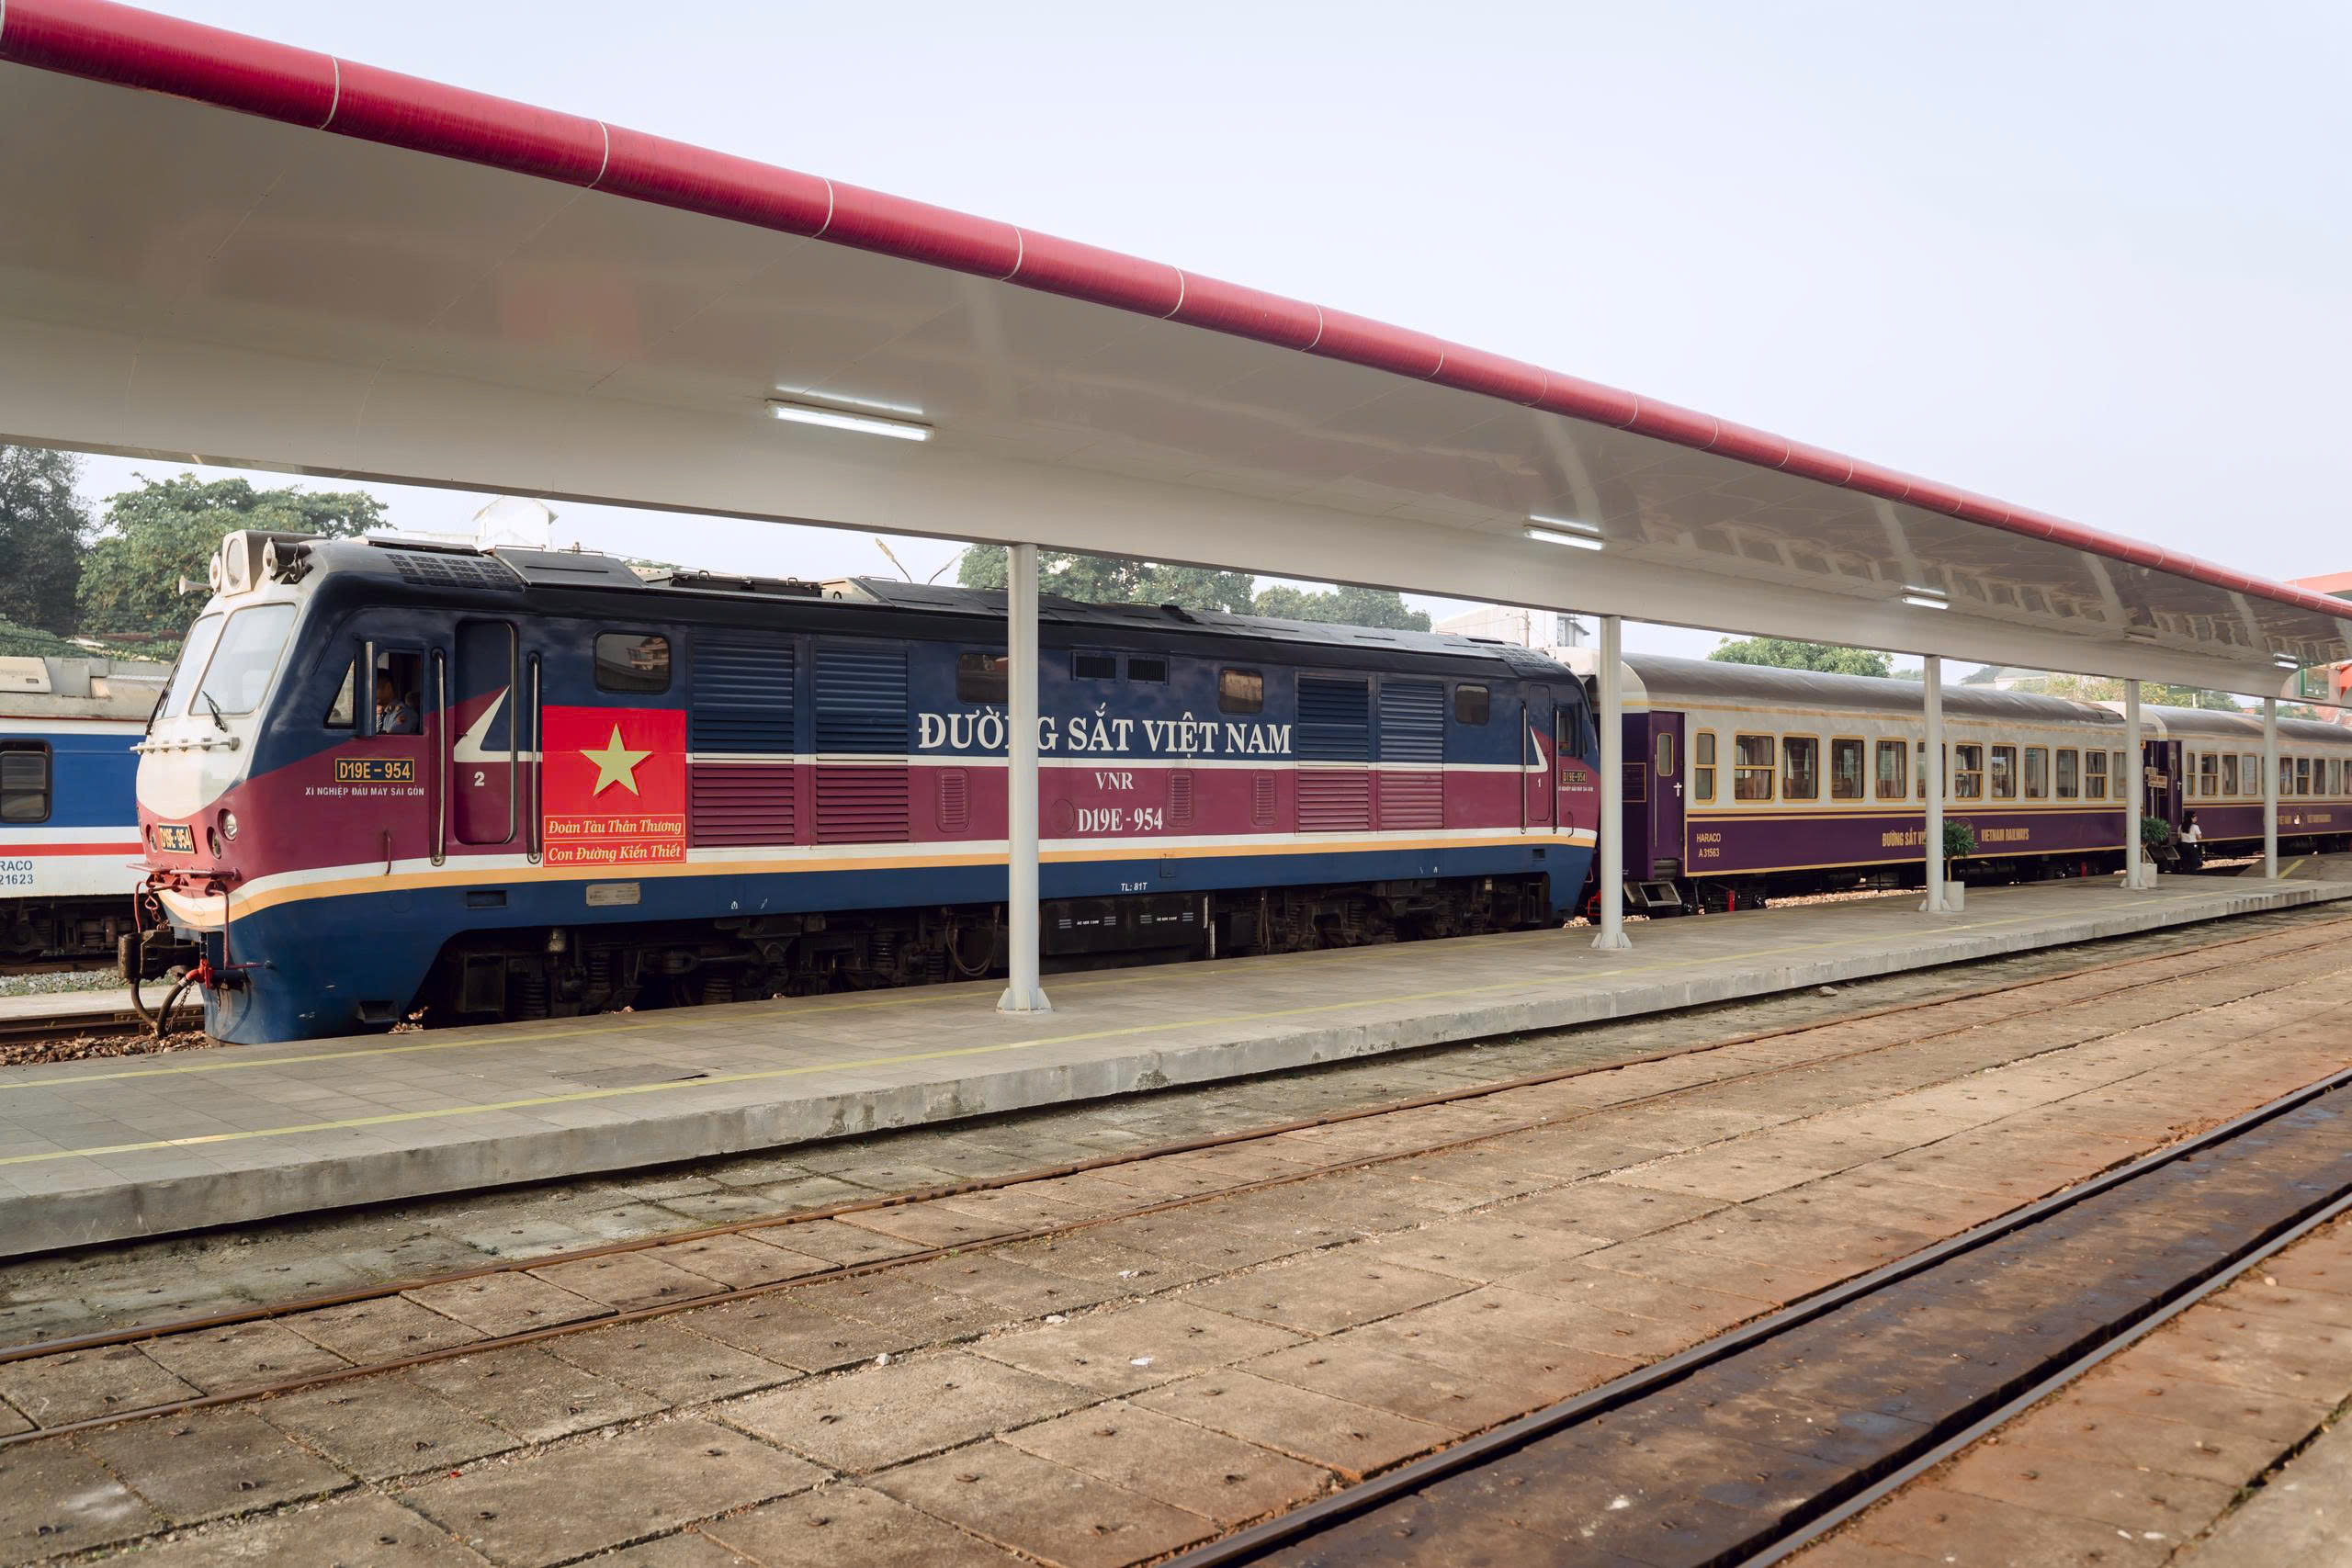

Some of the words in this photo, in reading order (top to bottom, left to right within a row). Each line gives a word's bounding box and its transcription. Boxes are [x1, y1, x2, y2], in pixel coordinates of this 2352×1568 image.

[919, 705, 1059, 750] ĐƯỜG
[1069, 702, 1134, 751] SẮT
[1142, 711, 1218, 759] VIỆT
[1226, 723, 1293, 754] NAM
[474, 771, 485, 786] 2
[1094, 772, 1134, 791] VNR
[1537, 778, 1542, 788] 1
[317, 784, 348, 798] NGHIỆP
[370, 784, 387, 795] MÁY
[548, 820, 581, 834] Đoàn
[582, 819, 605, 833] Tàu
[607, 818, 635, 833] Thân
[639, 818, 682, 834] Thương
[1696, 832, 1721, 843] HARACO
[548, 847, 573, 861] Con
[576, 846, 616, 862] Đường
[619, 843, 648, 859] Kiến
[650, 842, 681, 858] Thiết
[1121, 883, 1132, 892] TL:
[1134, 882, 1148, 891] 81T
